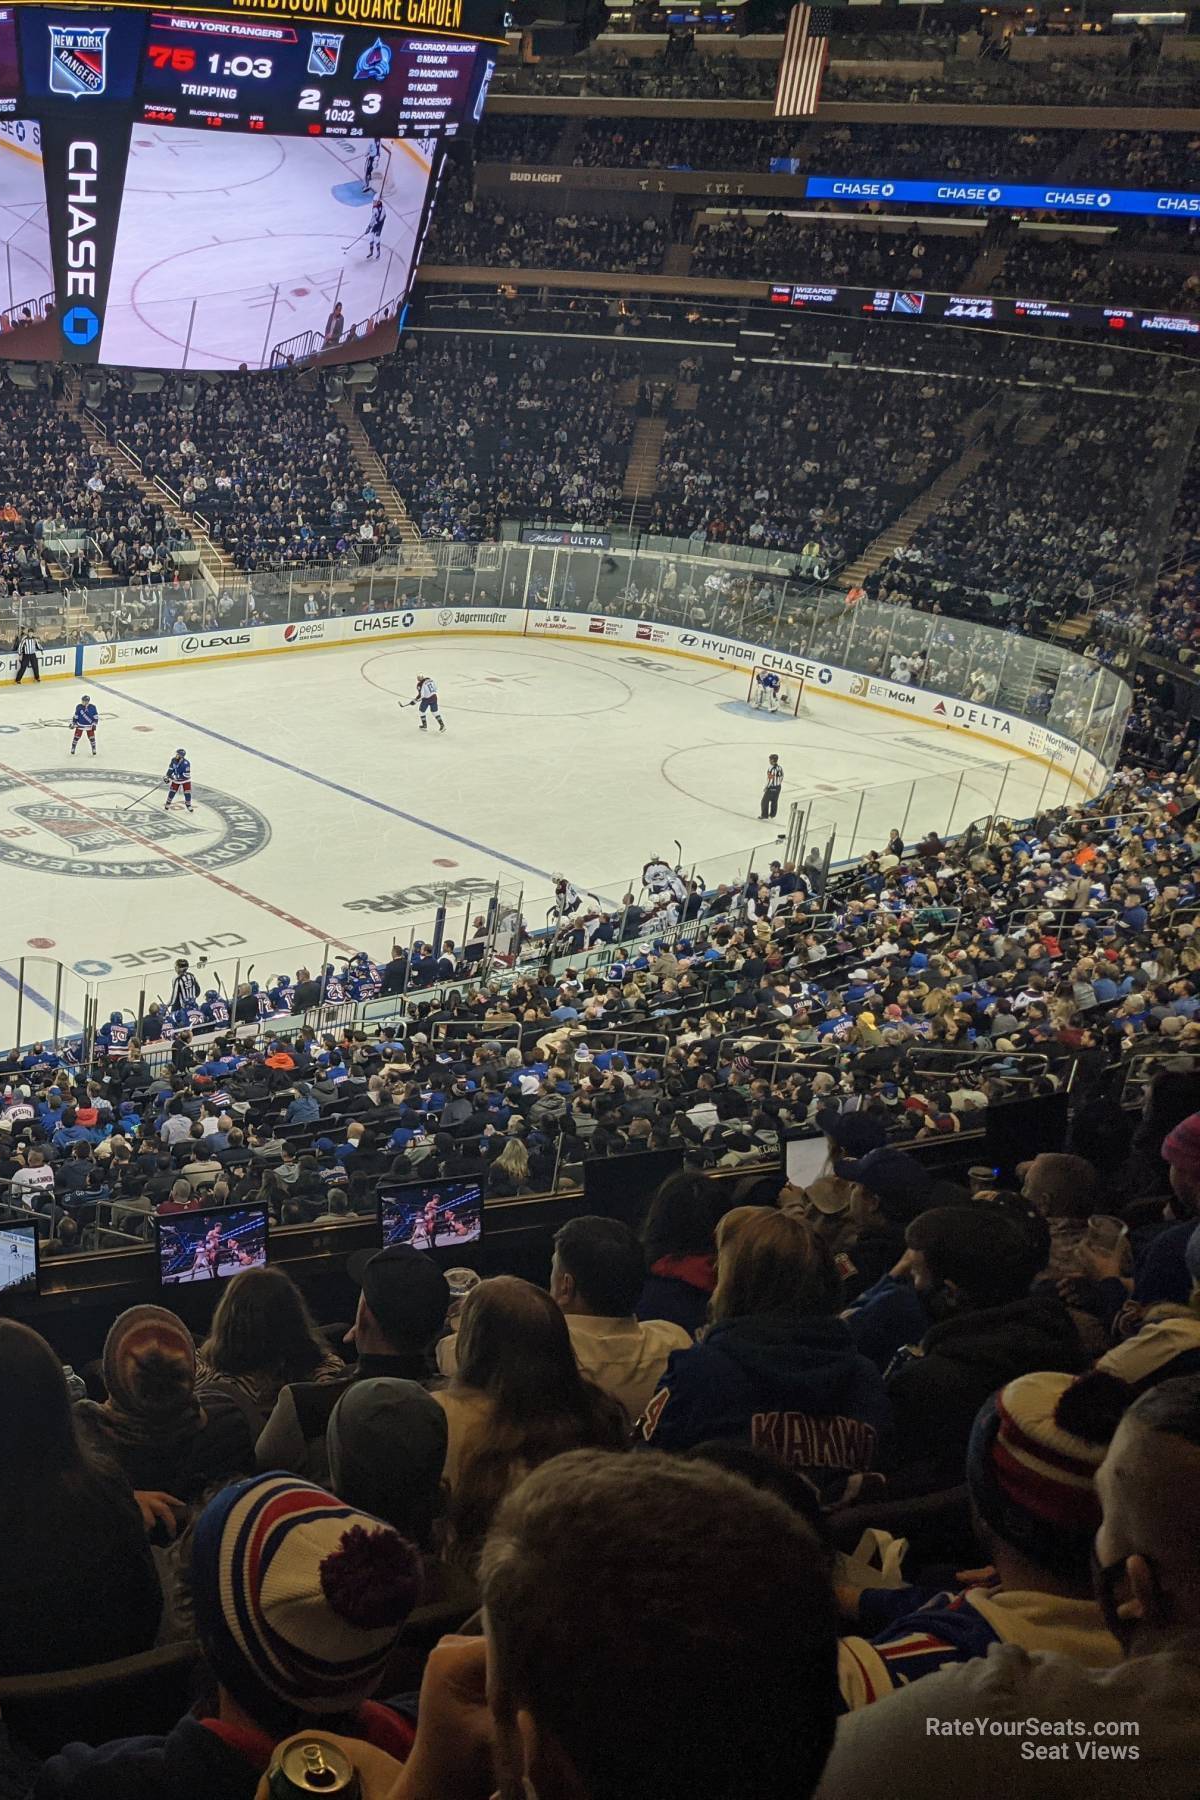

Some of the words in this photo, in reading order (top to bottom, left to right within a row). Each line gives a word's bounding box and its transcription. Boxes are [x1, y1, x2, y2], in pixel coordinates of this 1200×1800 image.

[336, 0, 401, 20] SQUARE
[407, 0, 462, 28] GARDEN
[171, 18, 198, 29] NEW
[200, 21, 230, 34] YORK
[231, 25, 282, 39] RANGERS
[54, 35, 73, 47] NEW
[77, 35, 102, 47] YORK
[409, 43, 444, 51] COLORADO
[148, 45, 196, 72] 75
[209, 53, 273, 78] 1:03
[423, 56, 448, 65] MAKAR
[59, 49, 100, 90] RANGERS
[420, 69, 458, 79] MACKINNON
[181, 83, 238, 99] TRIPPING
[417, 83, 438, 92] KADRI
[298, 89, 321, 111] 2
[361, 93, 382, 114] 3
[333, 99, 351, 107] 2ND
[413, 97, 452, 106] LANDESKOG
[324, 109, 355, 122] 10:02
[411, 111, 446, 120] RANTANEN
[510, 172, 531, 182] BUD
[531, 173, 562, 183] LIGHT
[833, 183, 880, 196] CHASE
[937, 187, 986, 200] CHASE
[1045, 191, 1095, 205] CHASE
[67, 141, 97, 298] CHASE
[795, 286, 837, 295] WIZARDS
[795, 294, 833, 302] PISTONS
[949, 297, 993, 306] FACEOFFS
[944, 305, 993, 319] .444
[1103, 309, 1133, 318] SHOTS
[1141, 320, 1199, 333] RANGERS
[570, 536, 604, 547] ULTRA
[299, 620, 325, 636] pepsi
[354, 616, 400, 632] CHASE
[200, 634, 251, 649] LEXUS
[117, 645, 158, 658] BETMGM
[702, 638, 756, 661] HYUNDAI
[761, 654, 816, 680] CHASE
[870, 684, 916, 705] BETMGM
[953, 705, 1012, 734] DELTA
[1045, 732, 1078, 756] Northwell
[218, 802, 258, 832] NEW
[197, 835, 250, 867] YORK
[3, 848, 175, 878] RANGERS
[111, 932, 248, 969] CHASE
[11, 1108, 32, 1119] MESSIER
